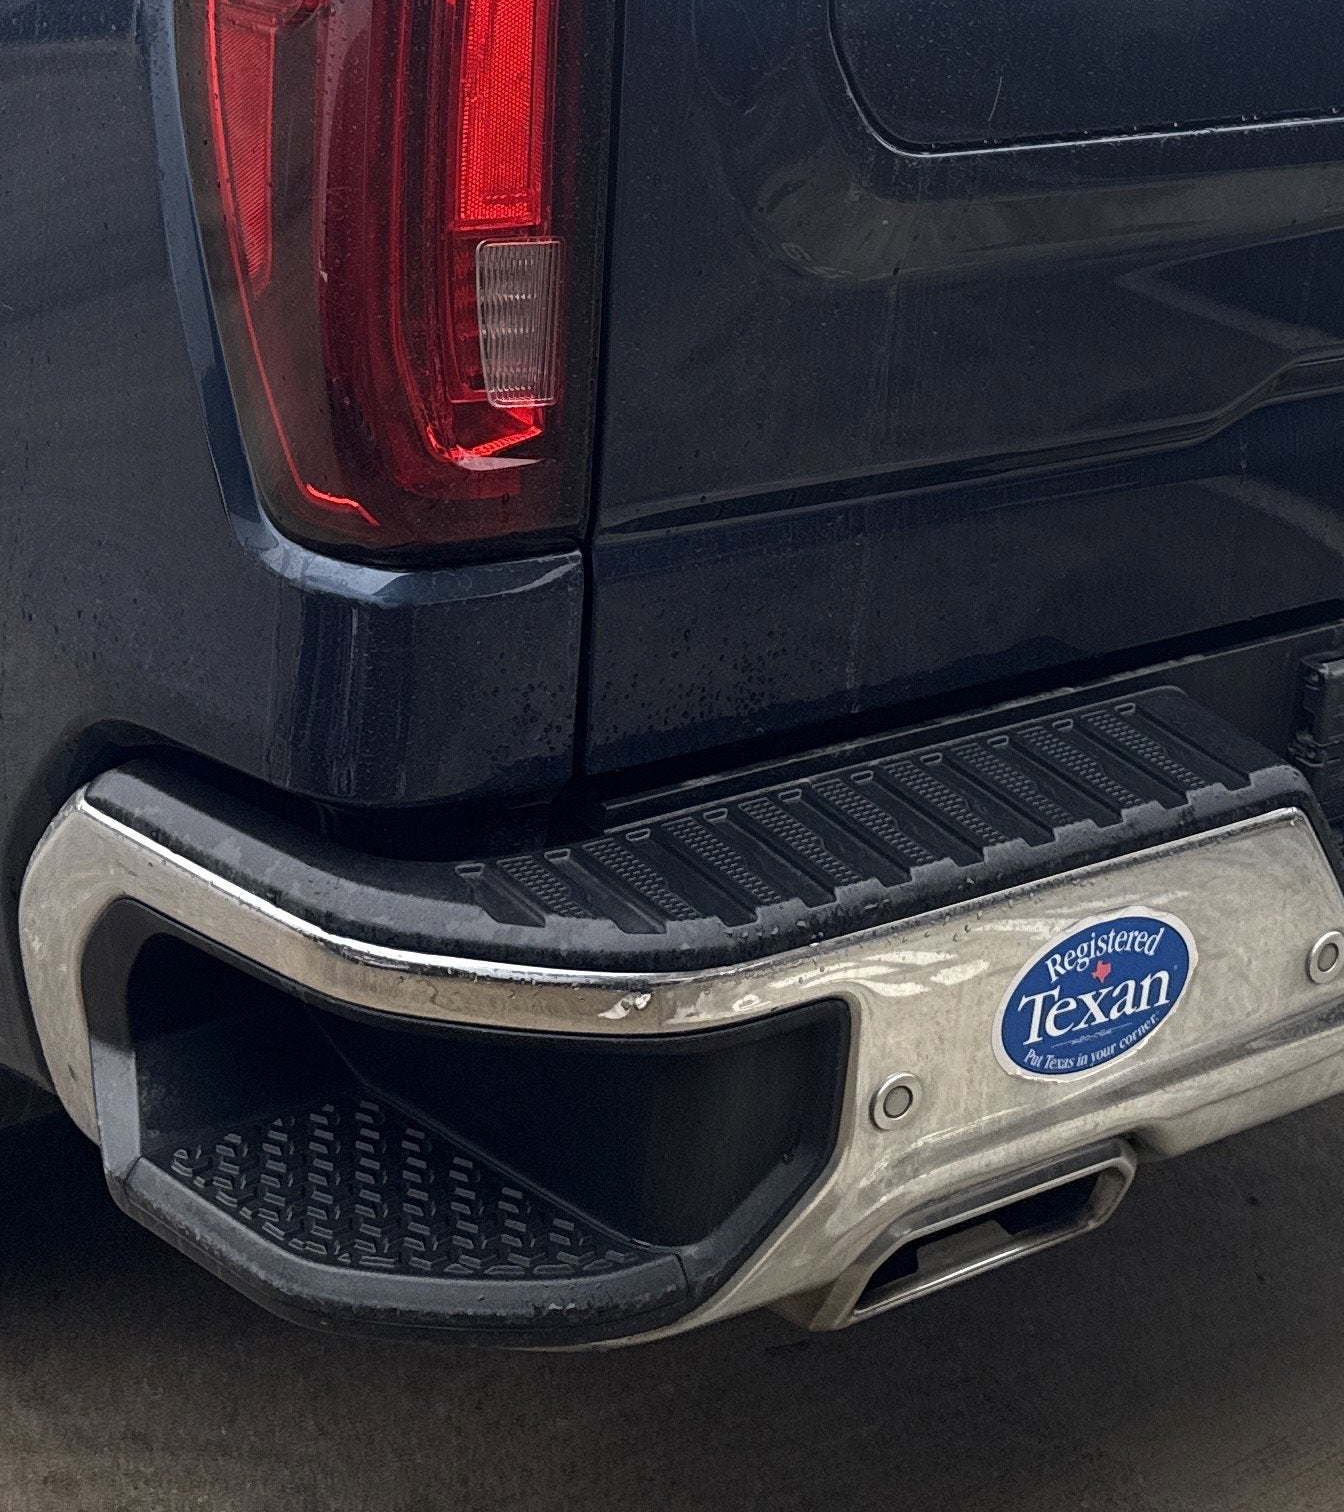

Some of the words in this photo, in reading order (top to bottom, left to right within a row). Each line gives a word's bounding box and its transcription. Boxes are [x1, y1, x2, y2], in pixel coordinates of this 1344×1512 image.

[1044, 927, 1165, 984] Registered
[1016, 968, 1171, 1046] Texan
[1023, 1048, 1044, 1068] Put
[1044, 1054, 1076, 1070] Texas
[1076, 1052, 1088, 1067] in
[1089, 1043, 1117, 1067] your
